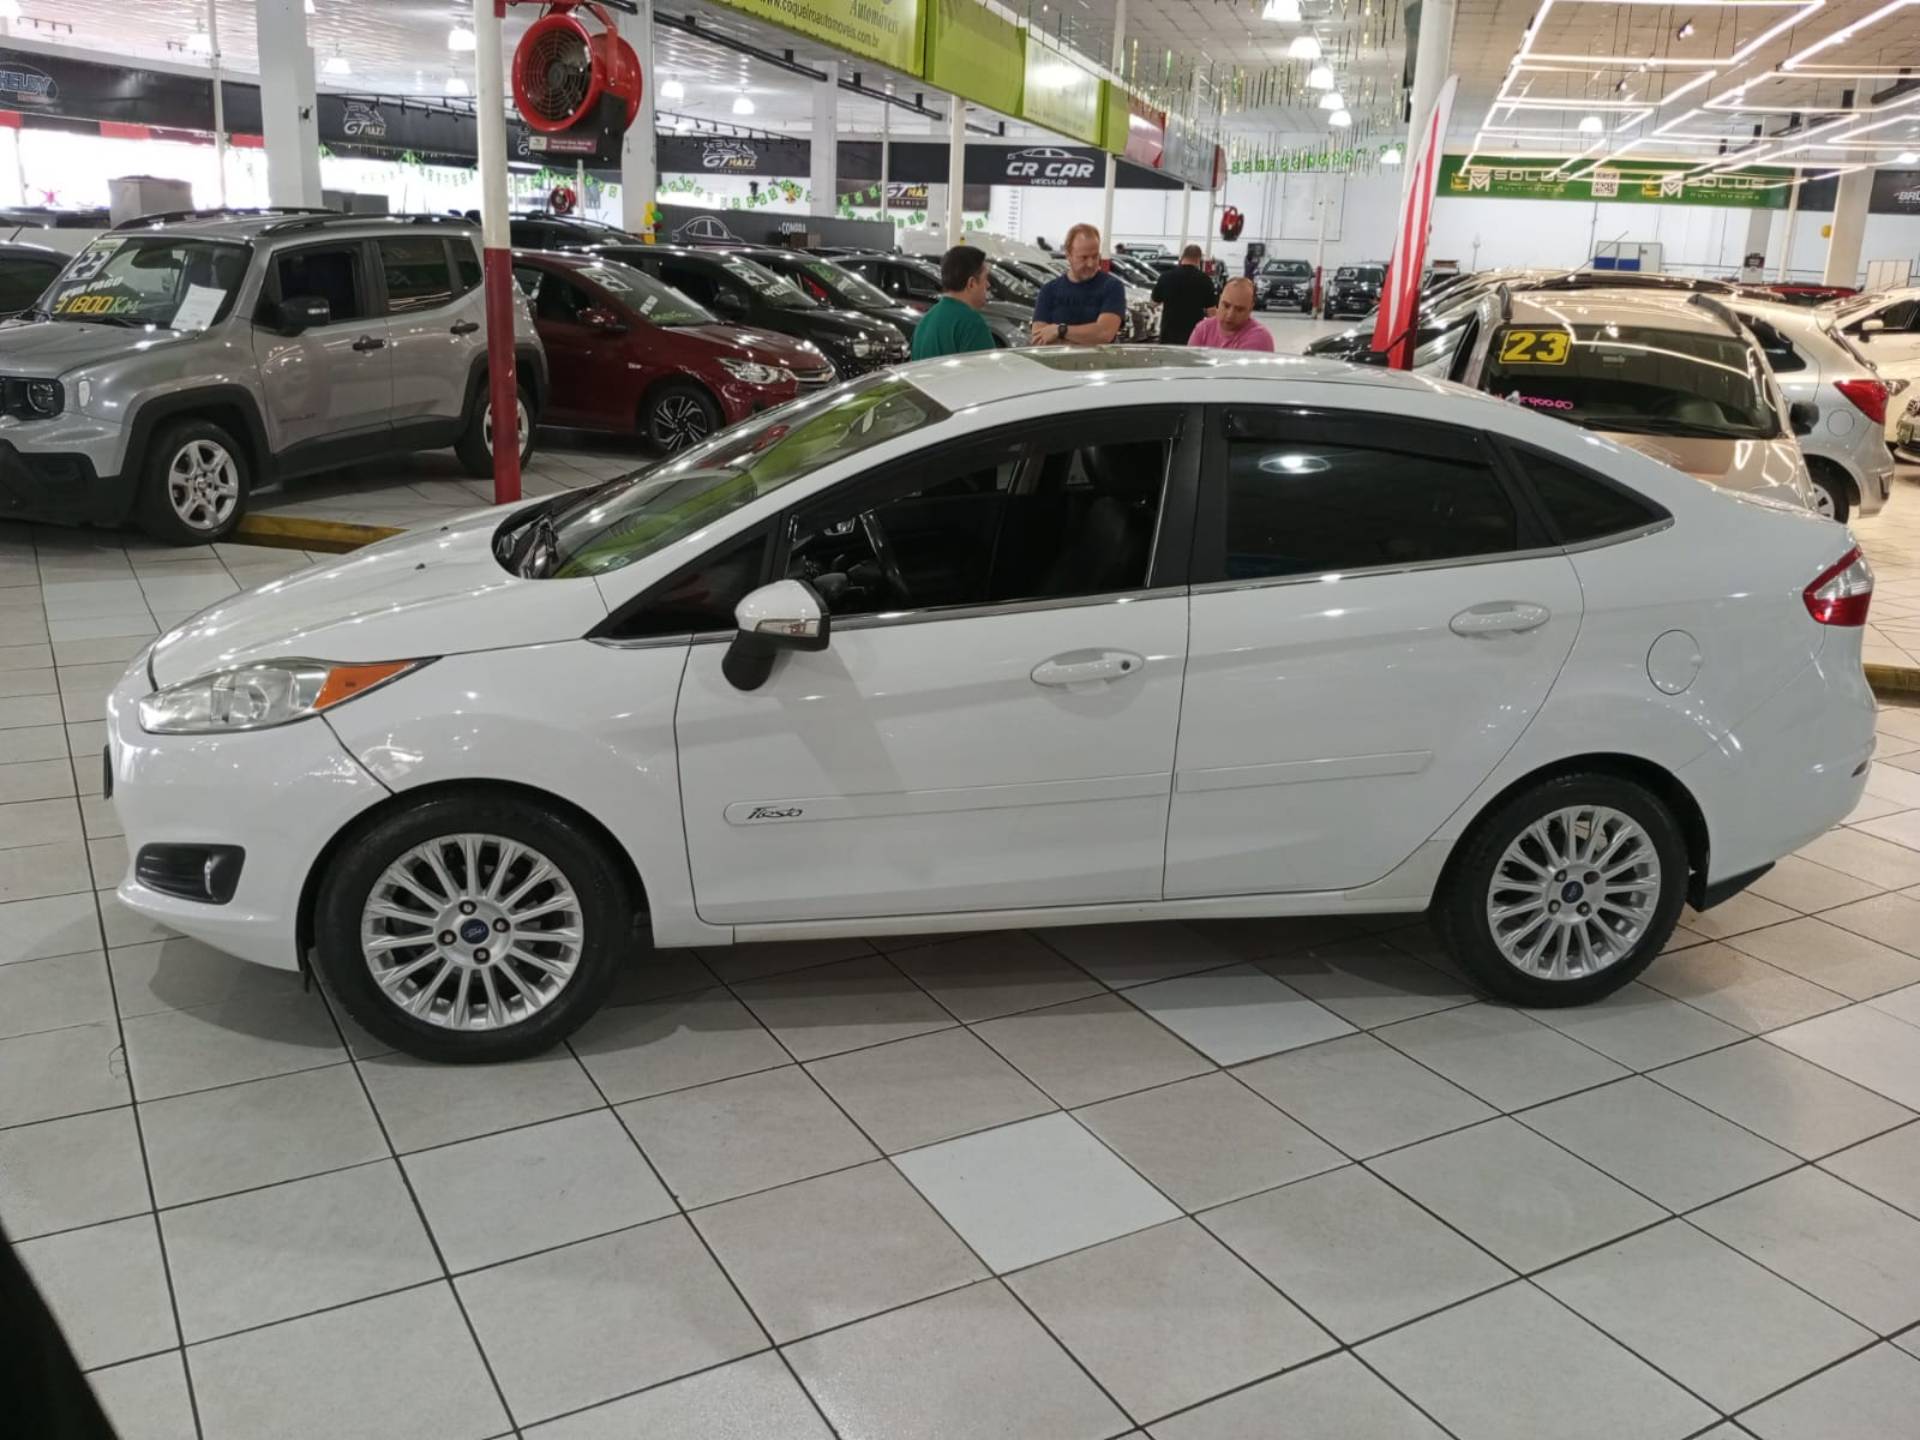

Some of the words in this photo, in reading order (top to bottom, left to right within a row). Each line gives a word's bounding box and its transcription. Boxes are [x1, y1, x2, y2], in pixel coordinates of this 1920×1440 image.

[703, 155, 737, 169] GT
[1006, 161, 1040, 177] CR
[1045, 163, 1095, 178] CAR
[1494, 169, 1570, 182] SOLUS
[1686, 177, 1767, 189] SOLUS
[66, 251, 109, 281] 23
[1503, 331, 1569, 361] 23
[746, 806, 803, 819] Fiesta
